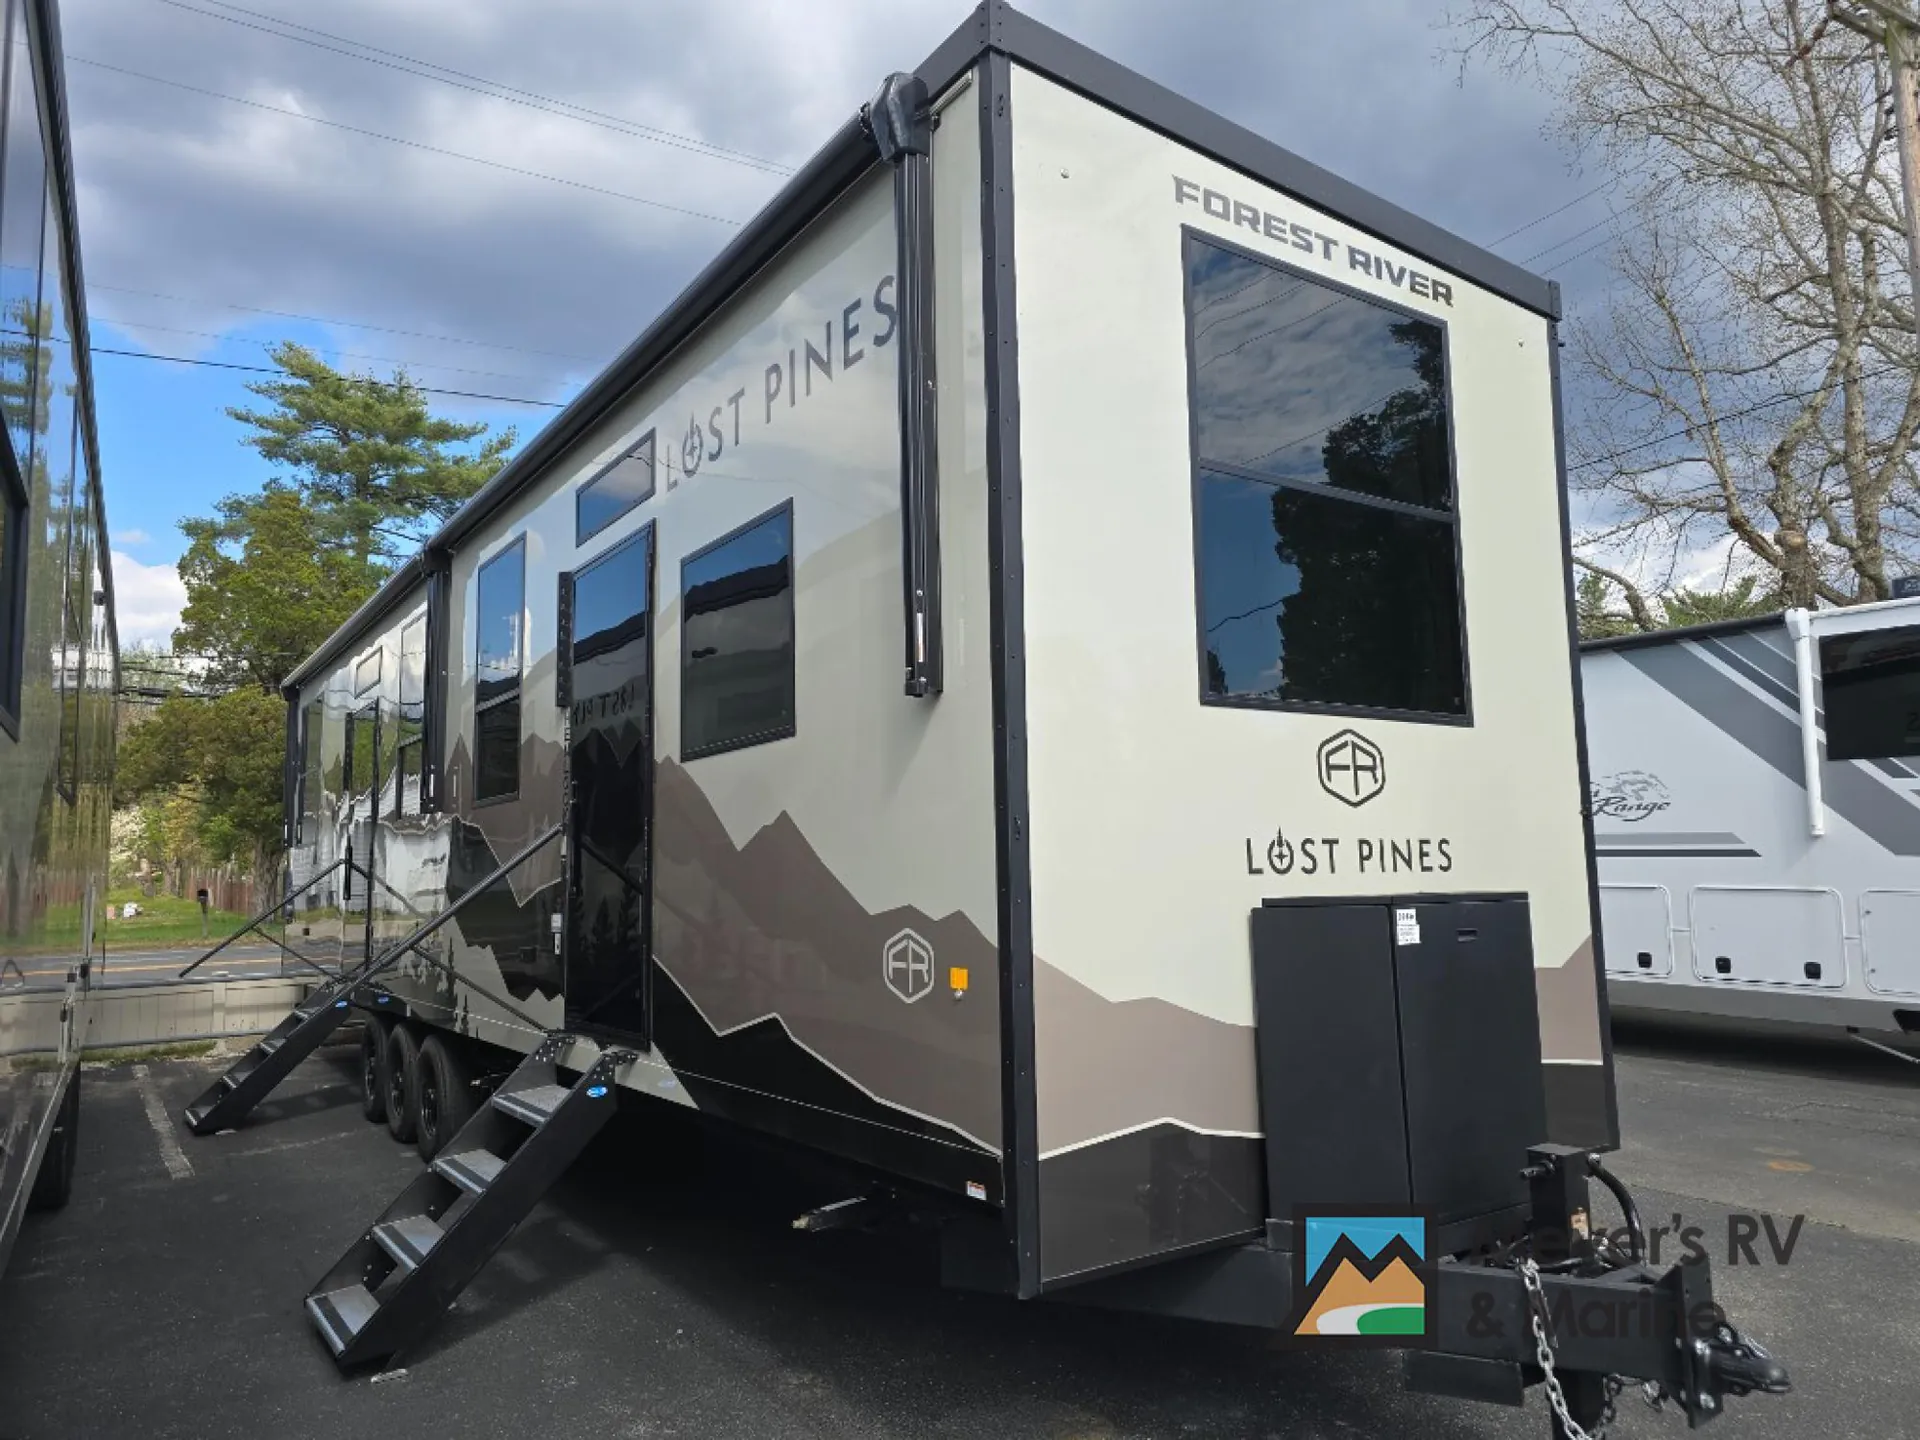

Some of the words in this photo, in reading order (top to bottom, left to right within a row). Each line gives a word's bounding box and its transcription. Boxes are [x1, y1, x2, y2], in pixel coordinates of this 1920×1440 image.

[1172, 174, 1340, 262] FOREST
[1347, 244, 1454, 308] RIVER
[666, 411, 746, 493] LOST
[764, 275, 898, 424] PINES
[1246, 825, 1340, 875] LOST
[1357, 837, 1453, 873] PINES
